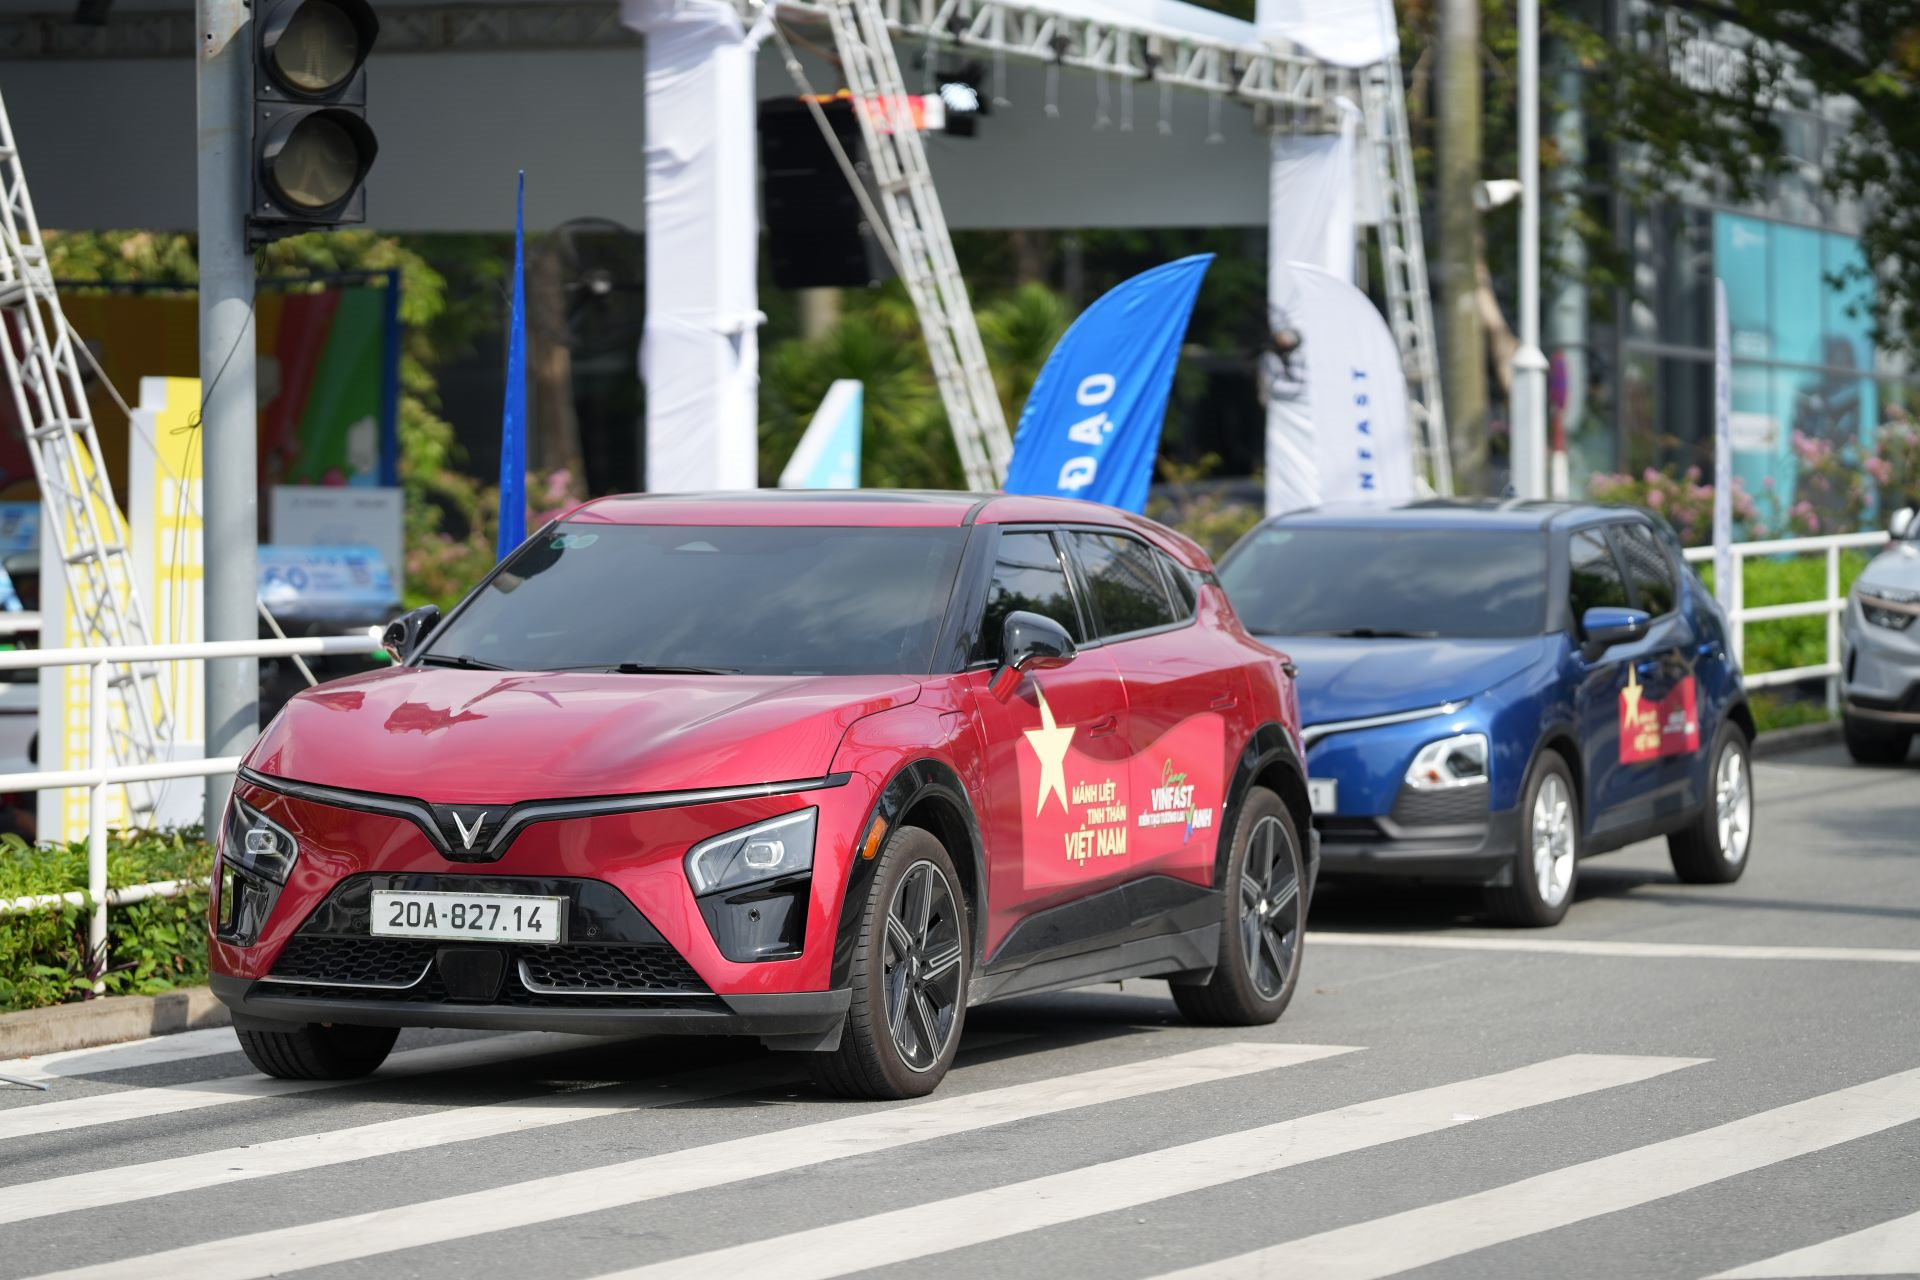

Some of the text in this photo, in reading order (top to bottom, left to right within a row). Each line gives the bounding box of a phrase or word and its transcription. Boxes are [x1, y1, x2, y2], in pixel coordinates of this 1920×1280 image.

[1057, 373, 1115, 491] ĐẠO
[1151, 785, 1195, 811] VINFAST
[1087, 808, 1105, 825] TINH
[1065, 823, 1127, 867] VIỆT NAM
[388, 901, 542, 933] 20A-827.14
